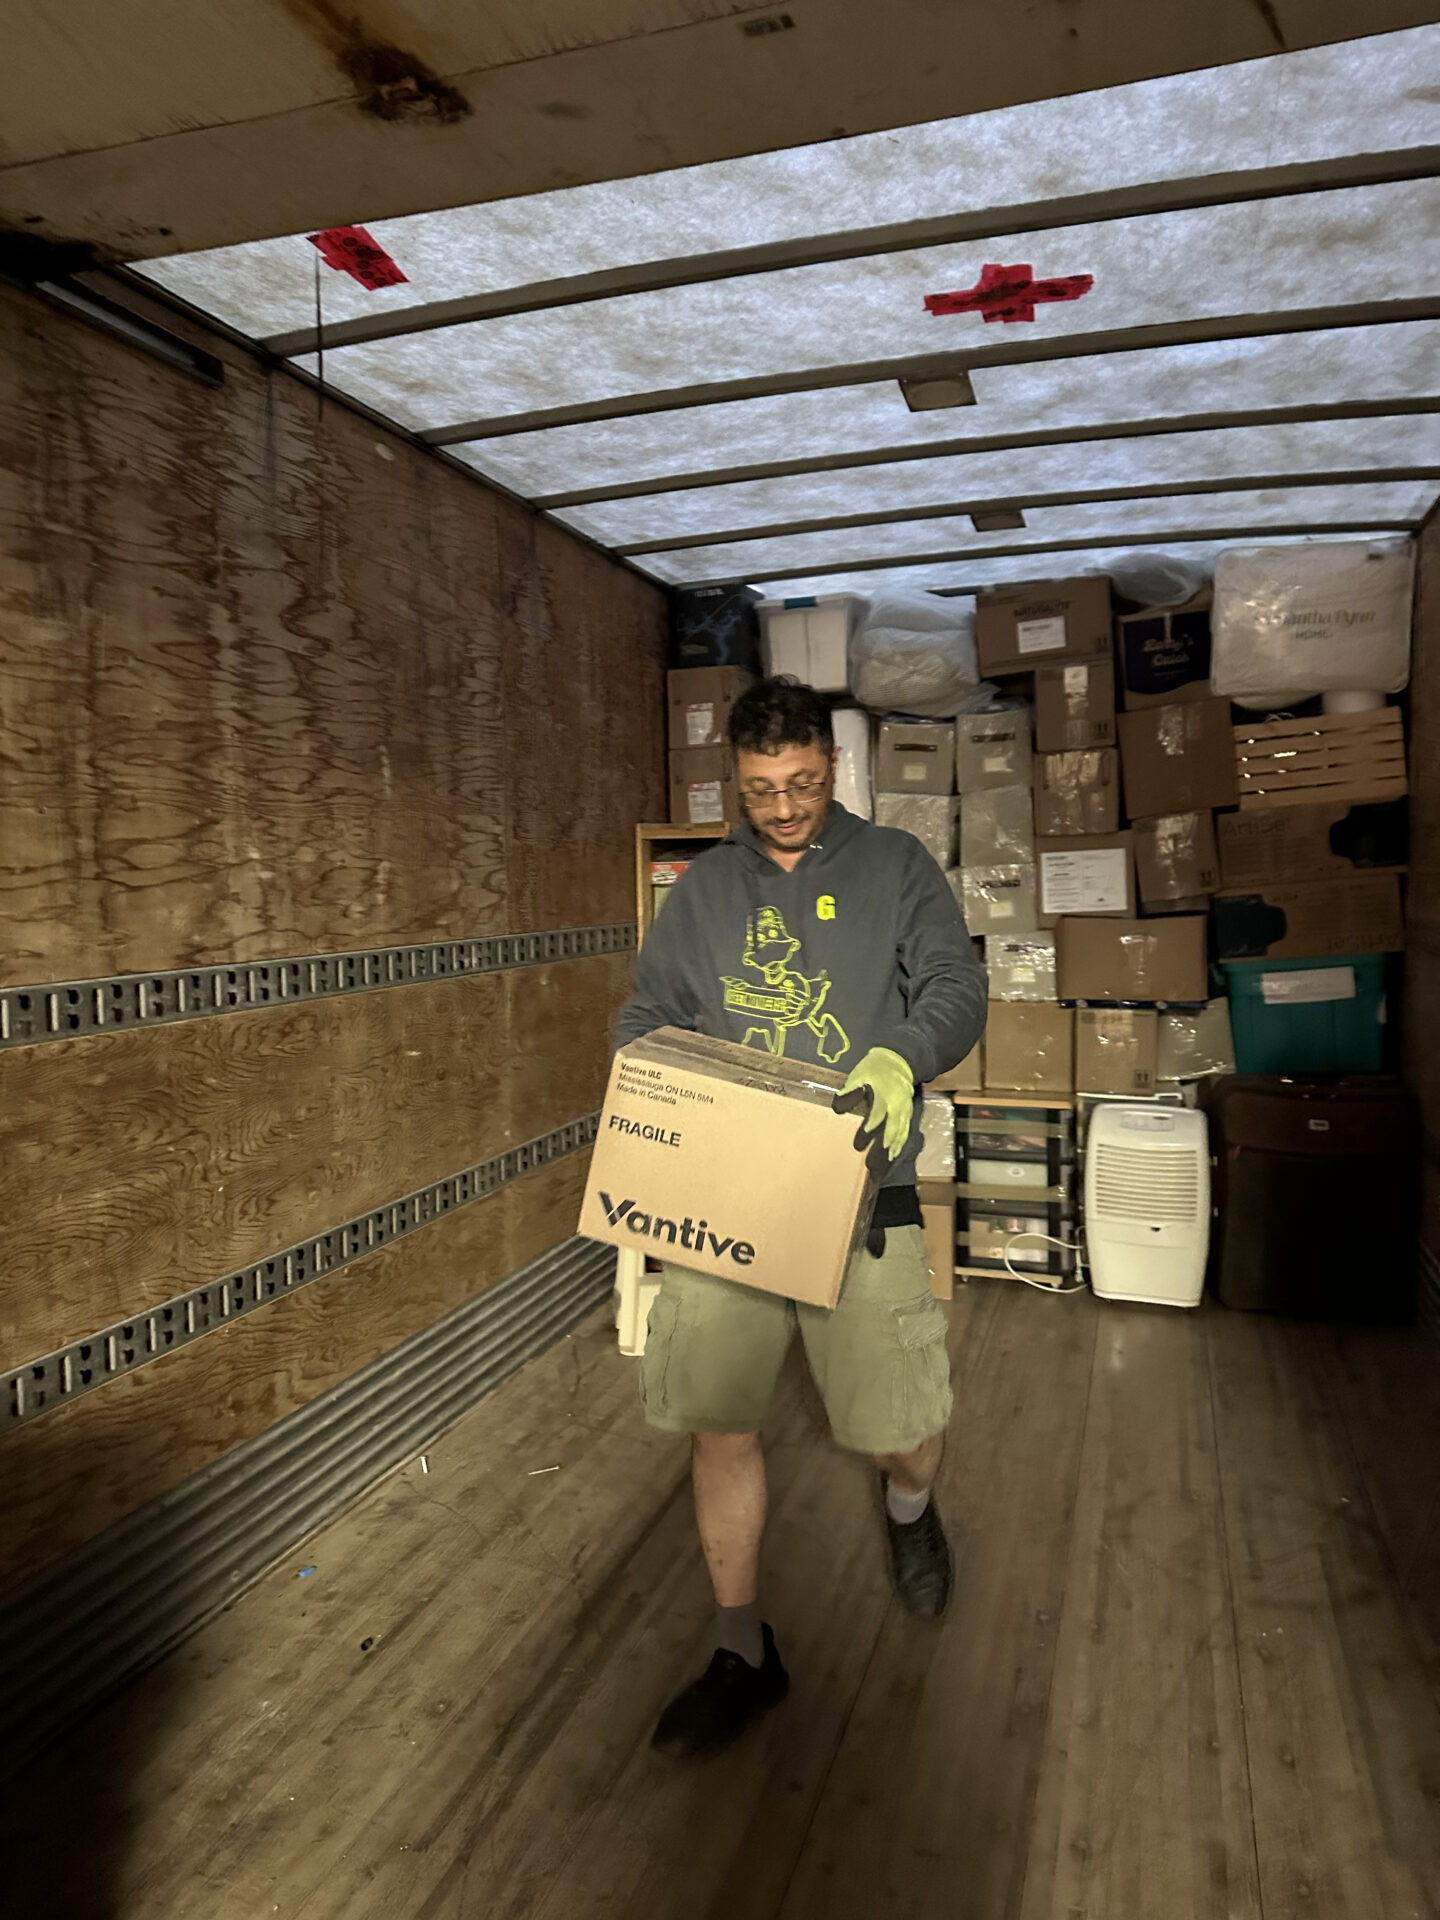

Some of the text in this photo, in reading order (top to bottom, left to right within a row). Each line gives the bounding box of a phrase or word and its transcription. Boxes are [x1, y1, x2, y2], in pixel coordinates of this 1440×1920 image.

[816, 895, 836, 921] G
[621, 1062, 662, 1080] Vantive ULC
[617, 1082, 677, 1105] Made in Canada
[619, 1073, 664, 1091] Mississauga
[665, 1085, 679, 1095] ON
[608, 1115, 681, 1147] FRAGILE
[598, 1191, 756, 1266] Vantive
